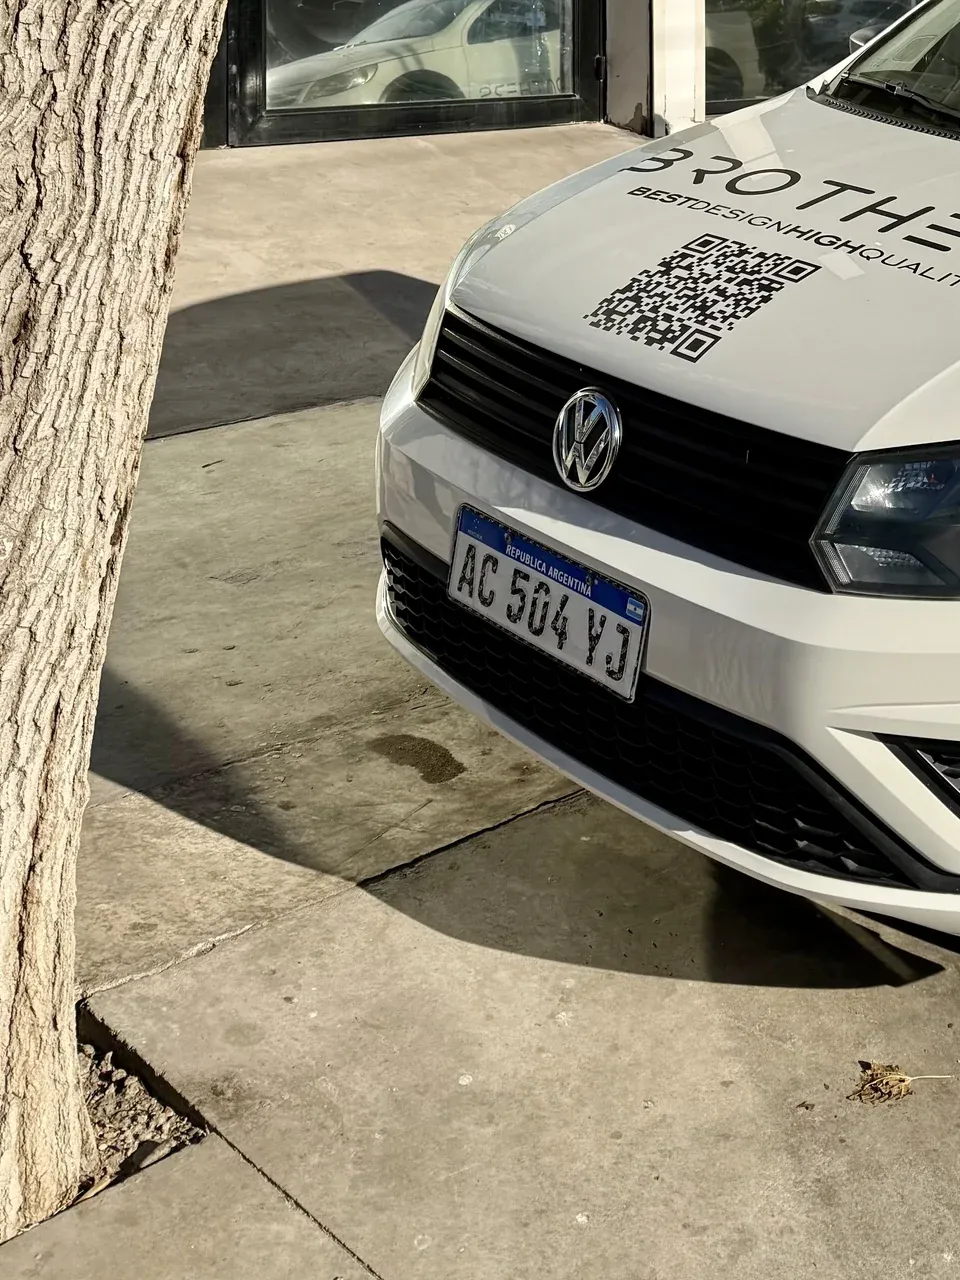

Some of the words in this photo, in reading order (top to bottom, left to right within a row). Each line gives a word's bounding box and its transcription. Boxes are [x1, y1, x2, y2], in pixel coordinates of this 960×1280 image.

[456, 543, 499, 608] AC
[506, 568, 570, 651] 504
[586, 607, 631, 682] YJ
[505, 544, 548, 574] REPUBLICA
[548, 566, 593, 597] ARGENTINA
